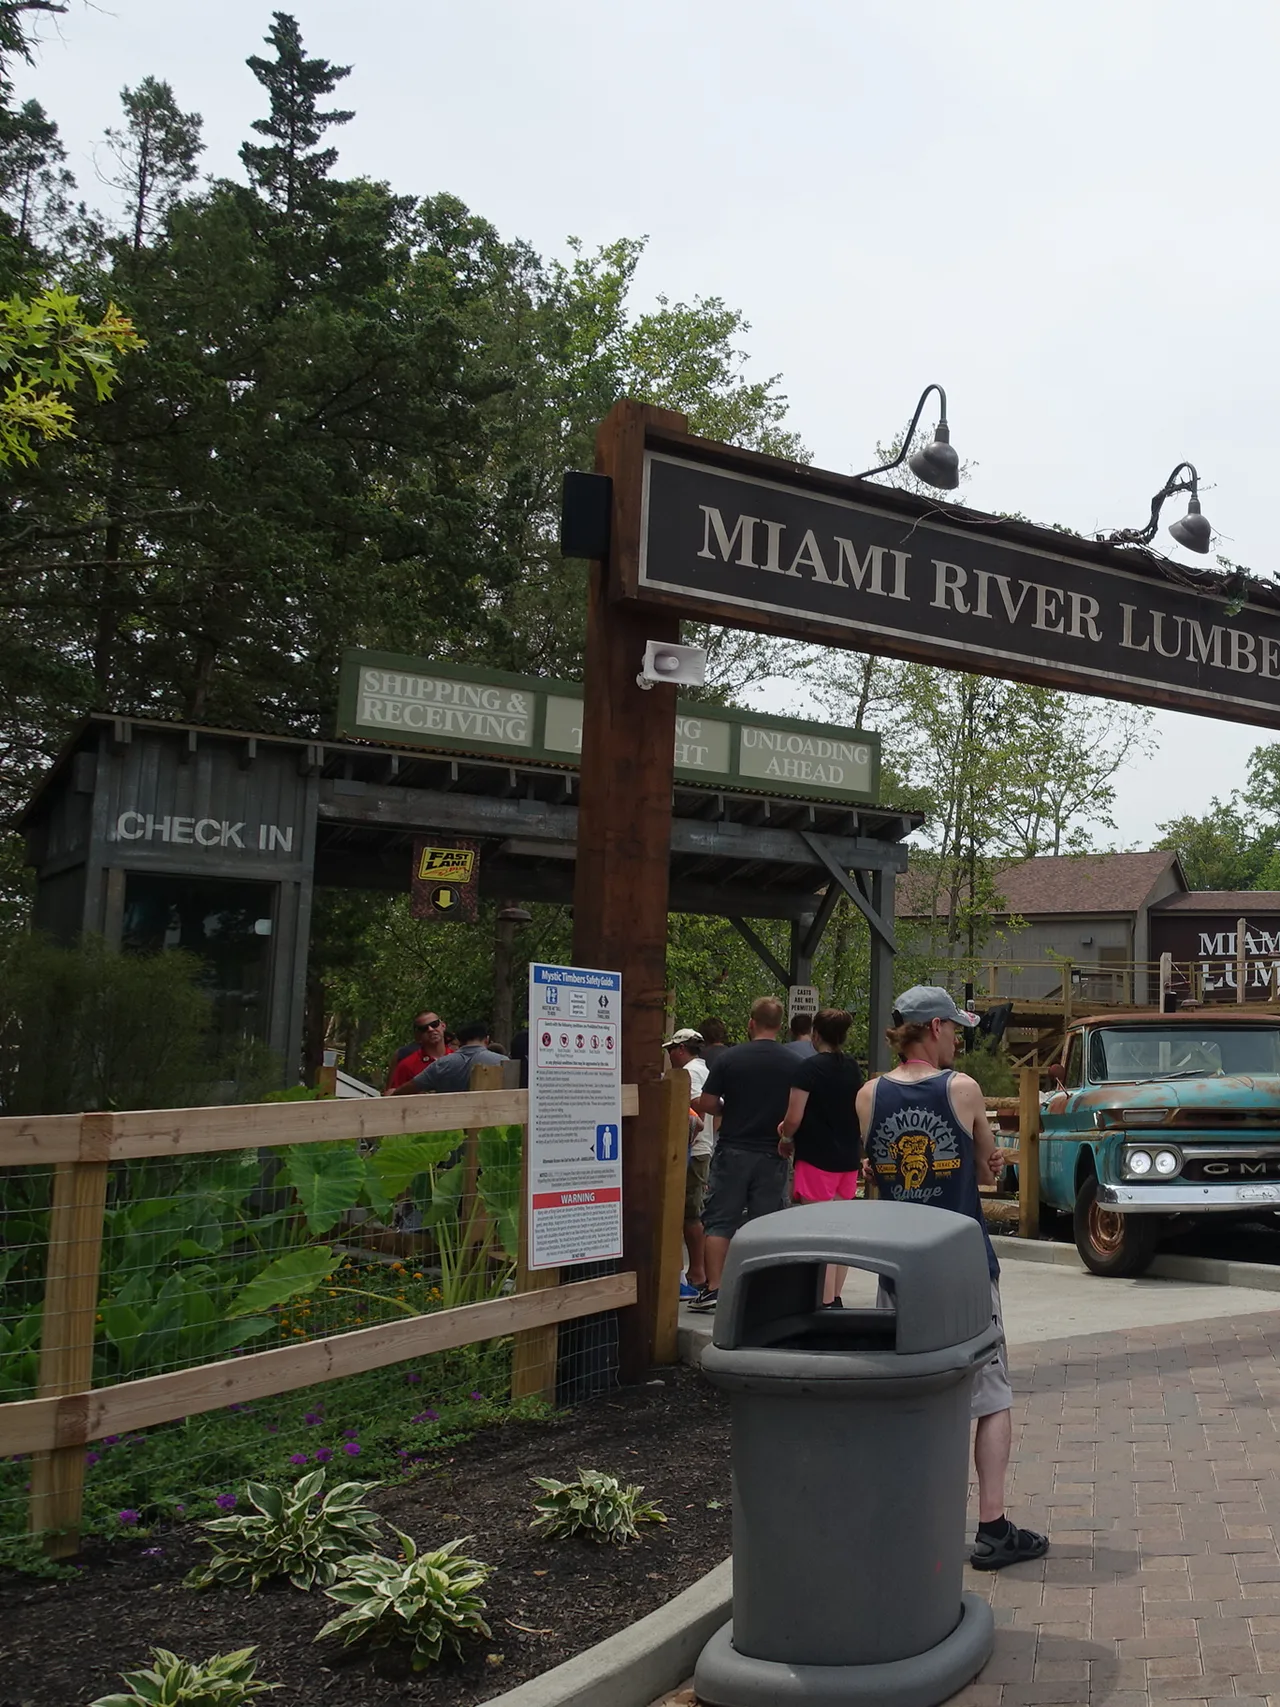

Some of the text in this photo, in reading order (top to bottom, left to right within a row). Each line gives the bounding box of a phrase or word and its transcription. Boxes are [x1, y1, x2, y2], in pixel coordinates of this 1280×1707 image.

[697, 504, 912, 601] MIAMI
[929, 558, 1103, 642] RIVER
[363, 670, 529, 716] SHIPPING &
[361, 698, 528, 742] RECEIVING
[741, 727, 869, 765] UNLOADING
[764, 756, 844, 784] AHEAD
[116, 810, 294, 852] CHECK IN
[425, 860, 467, 870] LANE
[428, 851, 470, 860] FAST
[541, 969, 614, 987] Mystic Timbers Safety Guide
[876, 1112, 954, 1159] GAS MONKEY
[560, 1192, 596, 1205] WARNING
[890, 1184, 944, 1203] Garage
